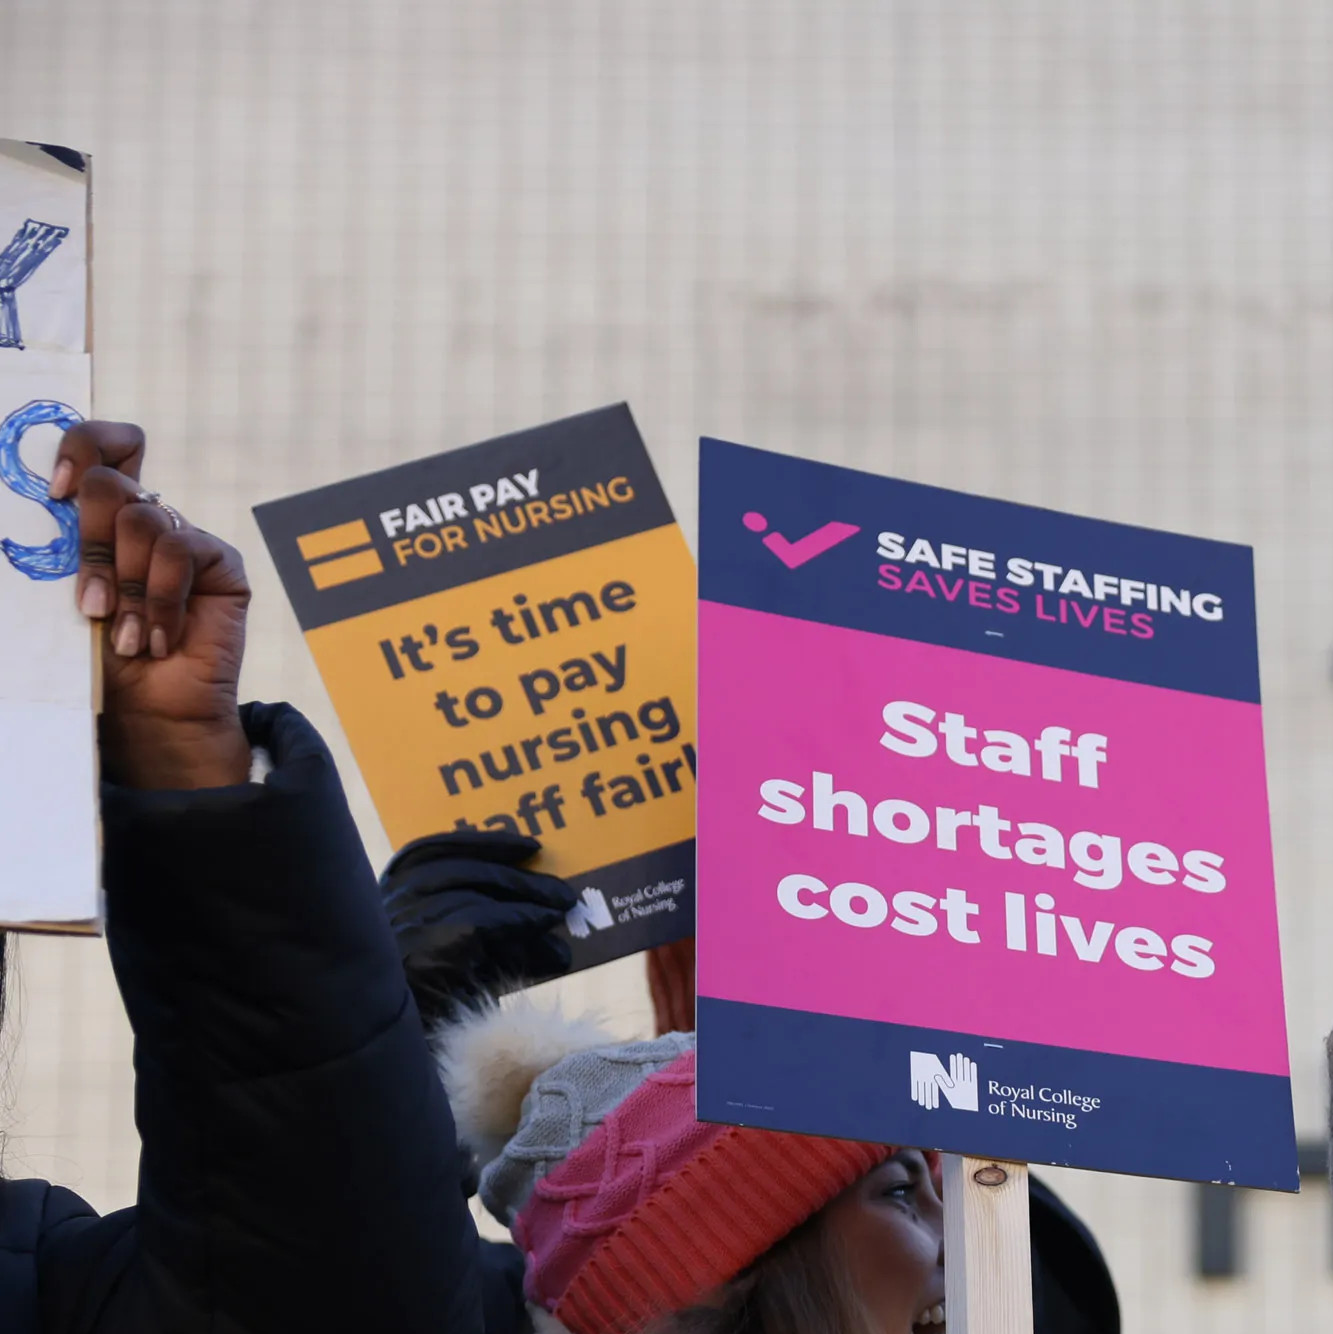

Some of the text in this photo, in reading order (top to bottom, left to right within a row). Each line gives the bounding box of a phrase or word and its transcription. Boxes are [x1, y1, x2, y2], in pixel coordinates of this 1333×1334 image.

[380, 468, 540, 537] FAIR PAY
[392, 476, 635, 566] FOR NURSING
[876, 531, 1223, 622] SAFE STAFFING
[877, 564, 1154, 640] SAVES LIVES
[379, 580, 637, 680] It's time
[434, 644, 627, 728] to pay
[438, 696, 682, 796] nursing
[879, 700, 1108, 789] Staff
[757, 771, 1227, 894] shortages
[776, 873, 1216, 979] cost lives
[988, 1080, 1101, 1113] Royal College
[988, 1101, 1078, 1130] of Nursing
